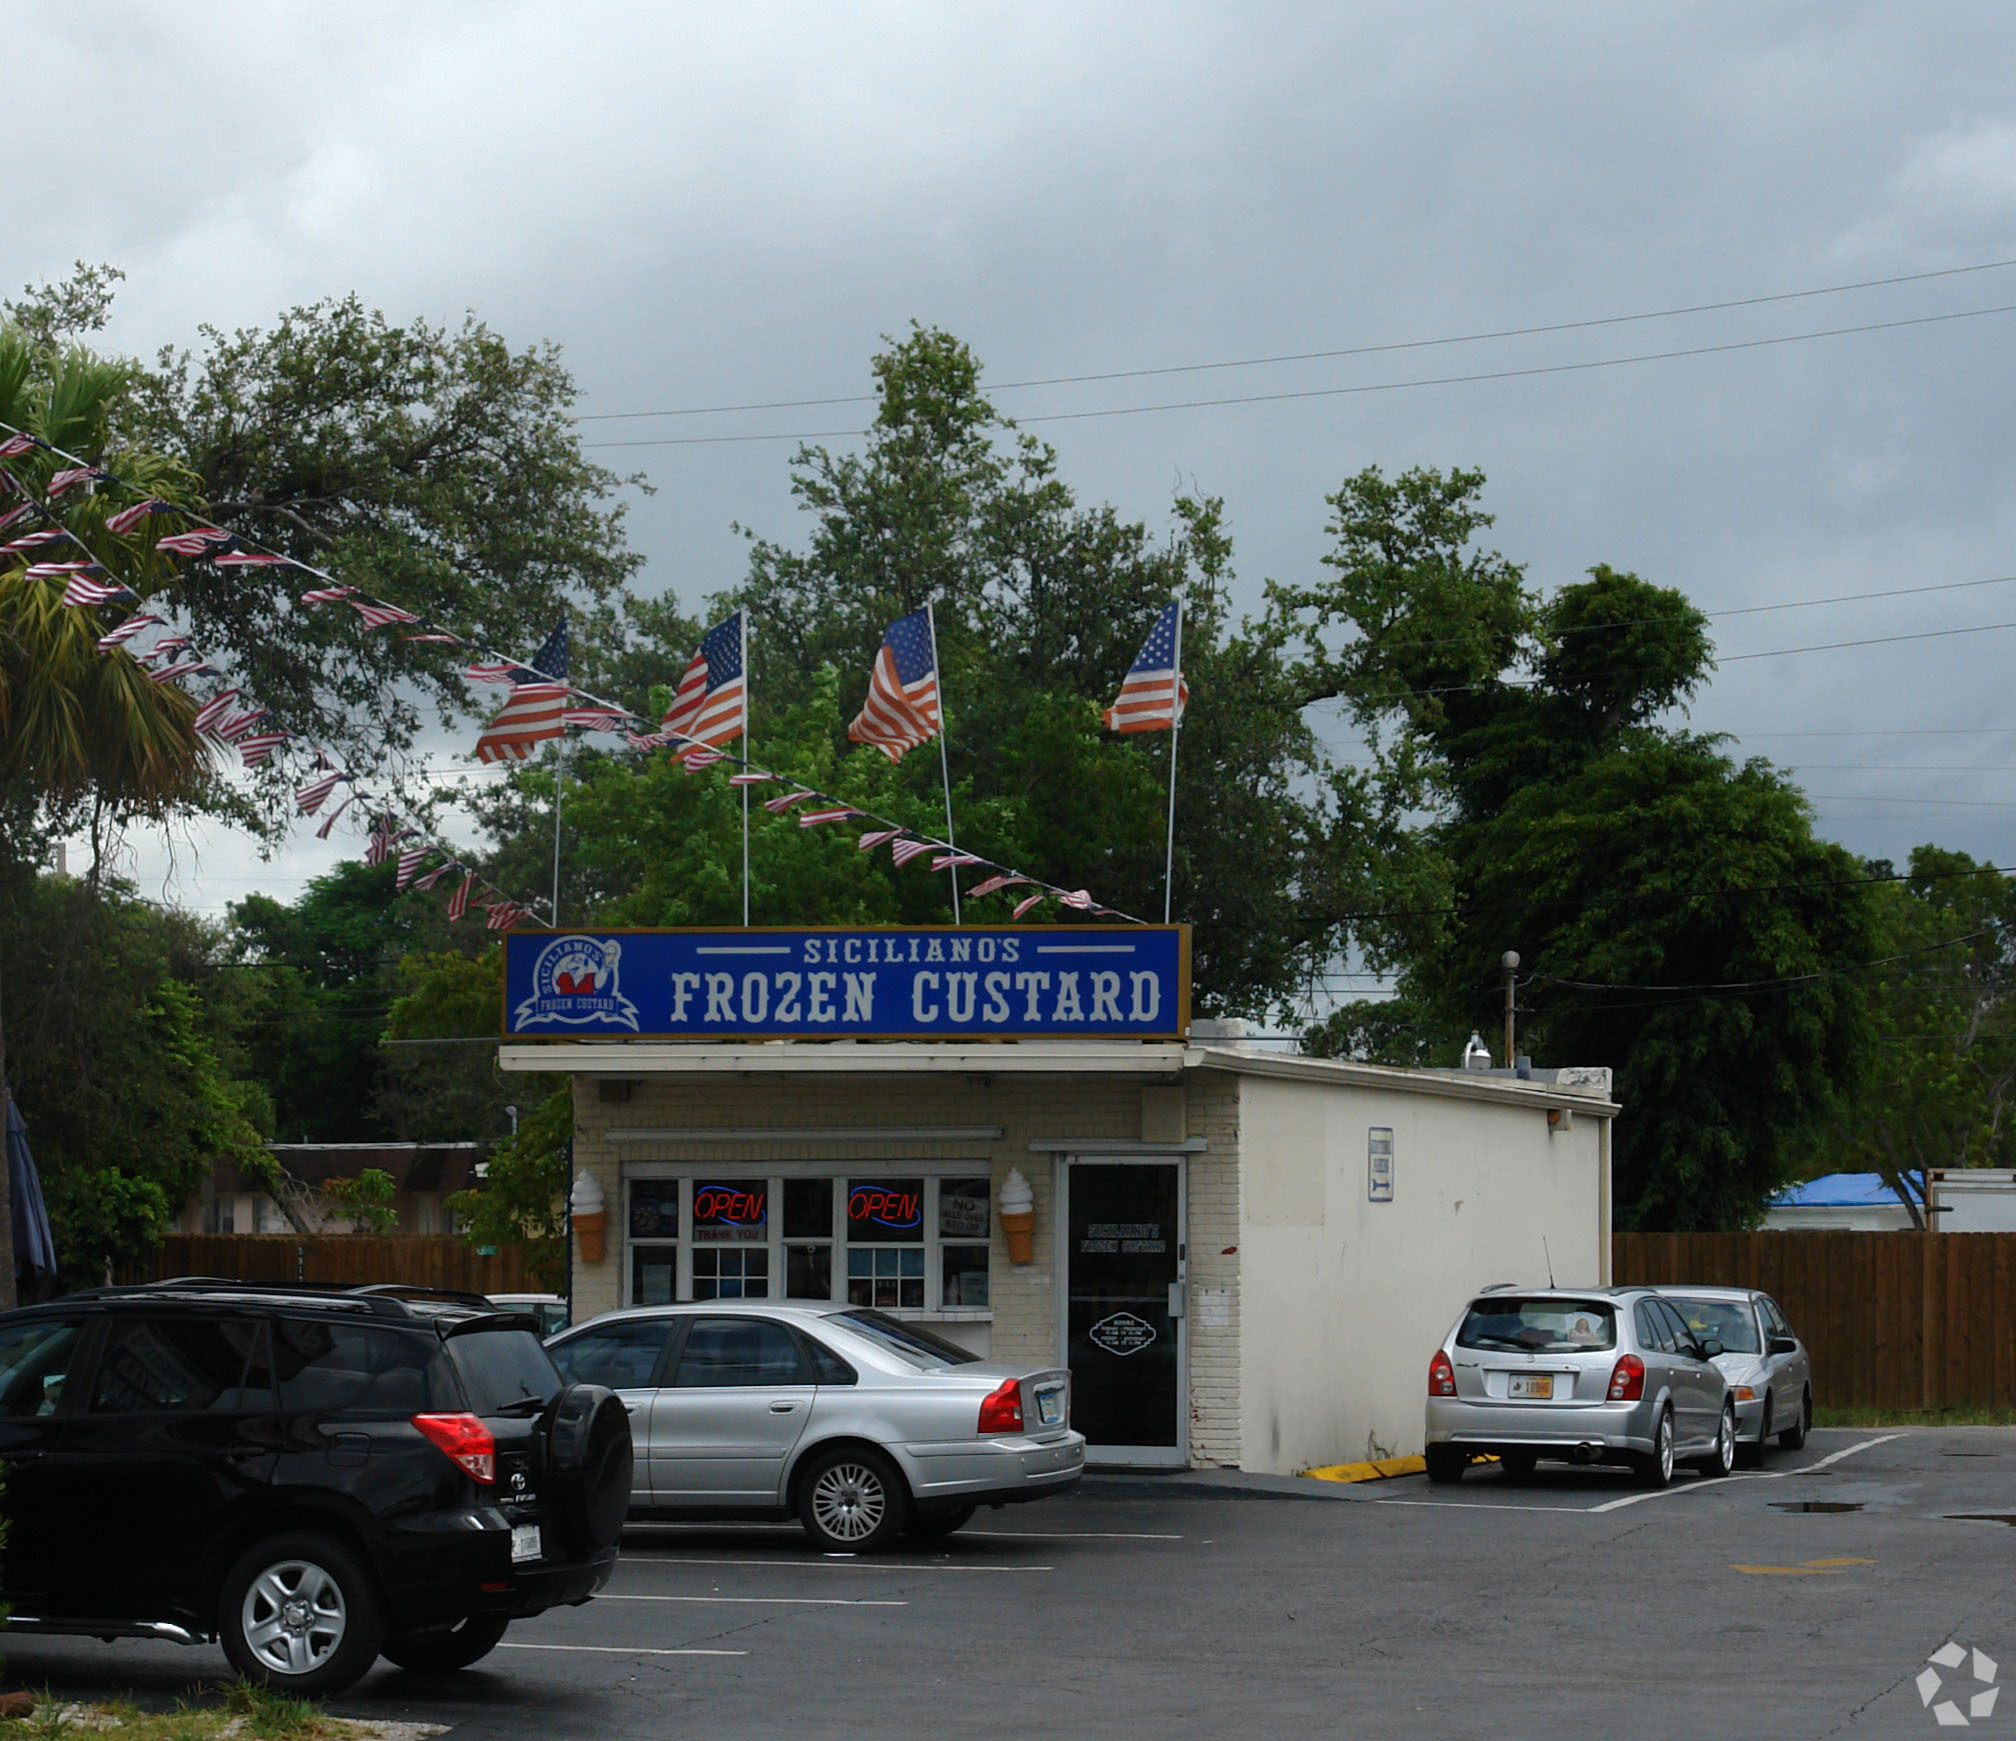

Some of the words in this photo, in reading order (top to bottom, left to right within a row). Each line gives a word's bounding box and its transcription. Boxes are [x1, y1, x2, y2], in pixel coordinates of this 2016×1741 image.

[804, 937, 1020, 963] SICILIANO'S
[576, 998, 615, 1010] CUSTARD
[671, 971, 877, 1023] FROZEN
[911, 970, 1162, 1023] CUSTARD
[695, 1194, 763, 1219] OPEN
[848, 1194, 919, 1219] OPEN
[953, 1199, 975, 1212] NO
[697, 1229, 733, 1240] THANK
[737, 1229, 760, 1240] YOU
